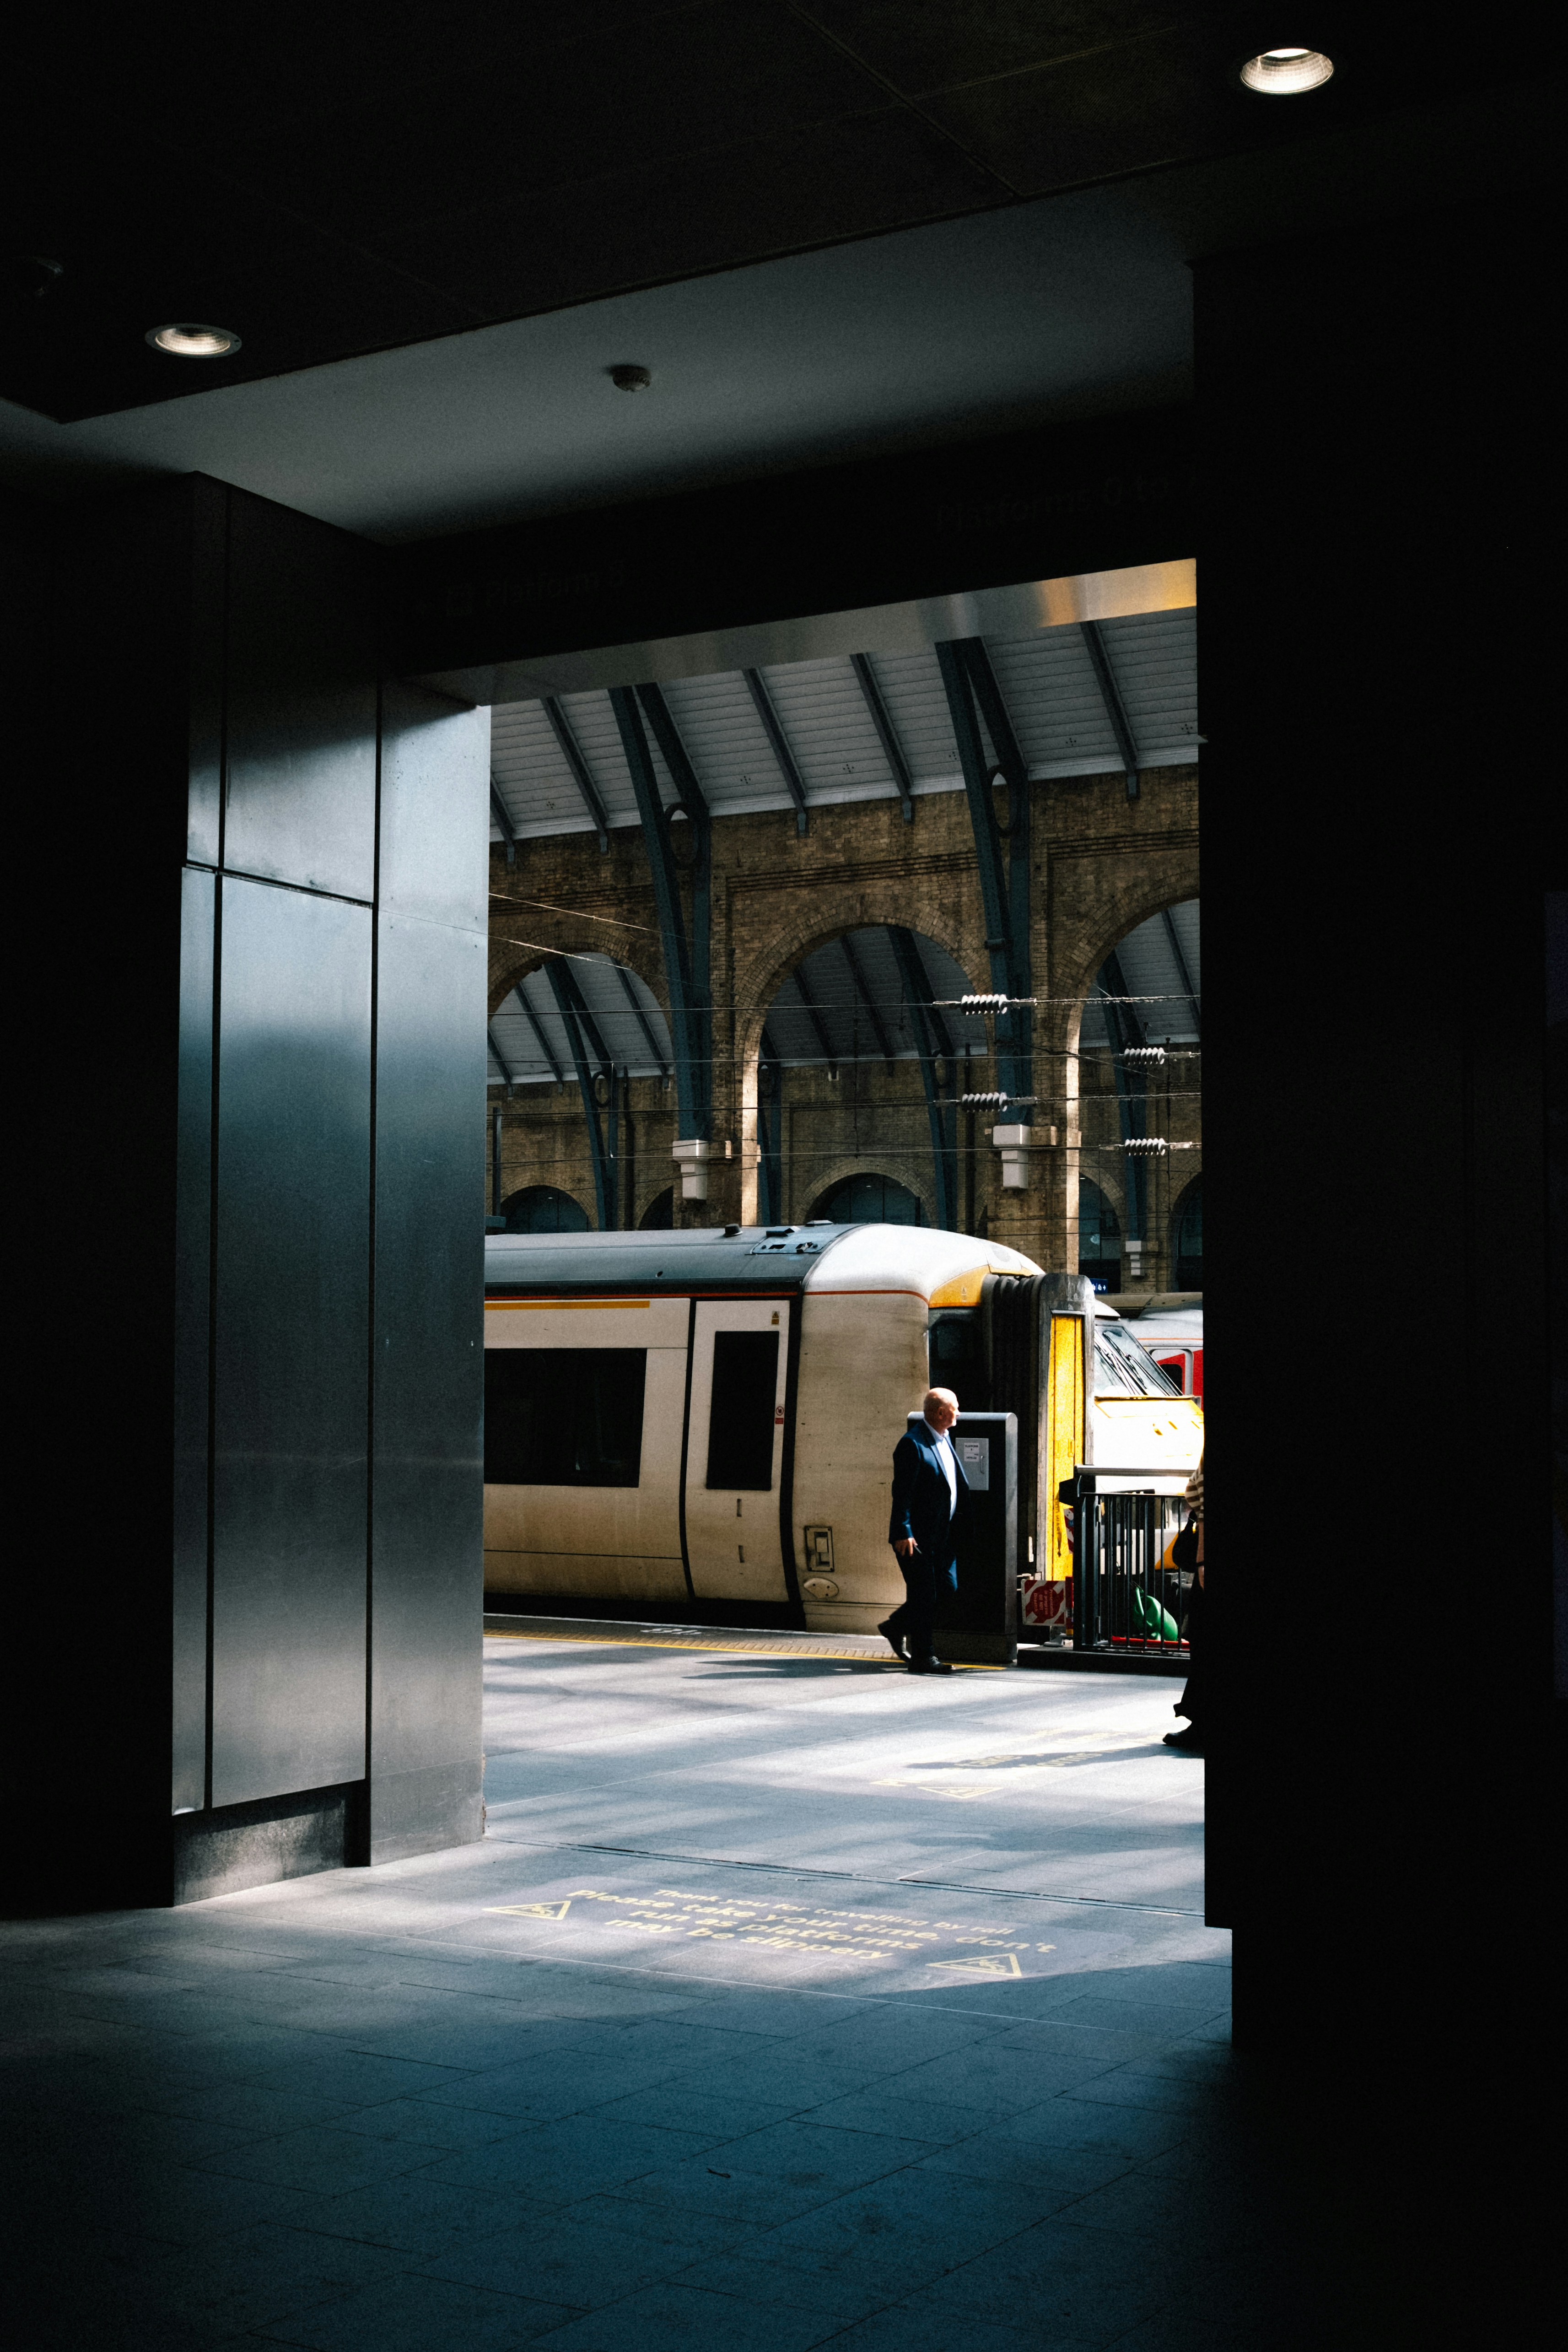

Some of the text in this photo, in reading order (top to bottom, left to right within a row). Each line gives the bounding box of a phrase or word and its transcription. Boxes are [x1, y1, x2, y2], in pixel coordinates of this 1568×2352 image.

[566, 1889, 1057, 1953] Please take your time, don't
[629, 1910, 925, 1949] run as platforms
[653, 1889, 721, 1902] Thank
[719, 1899, 769, 1907] you
[814, 1909, 929, 1926] travelling
[933, 1921, 967, 1930] by
[970, 1926, 1016, 1935] rail
[604, 1919, 894, 1959] may be slippery
